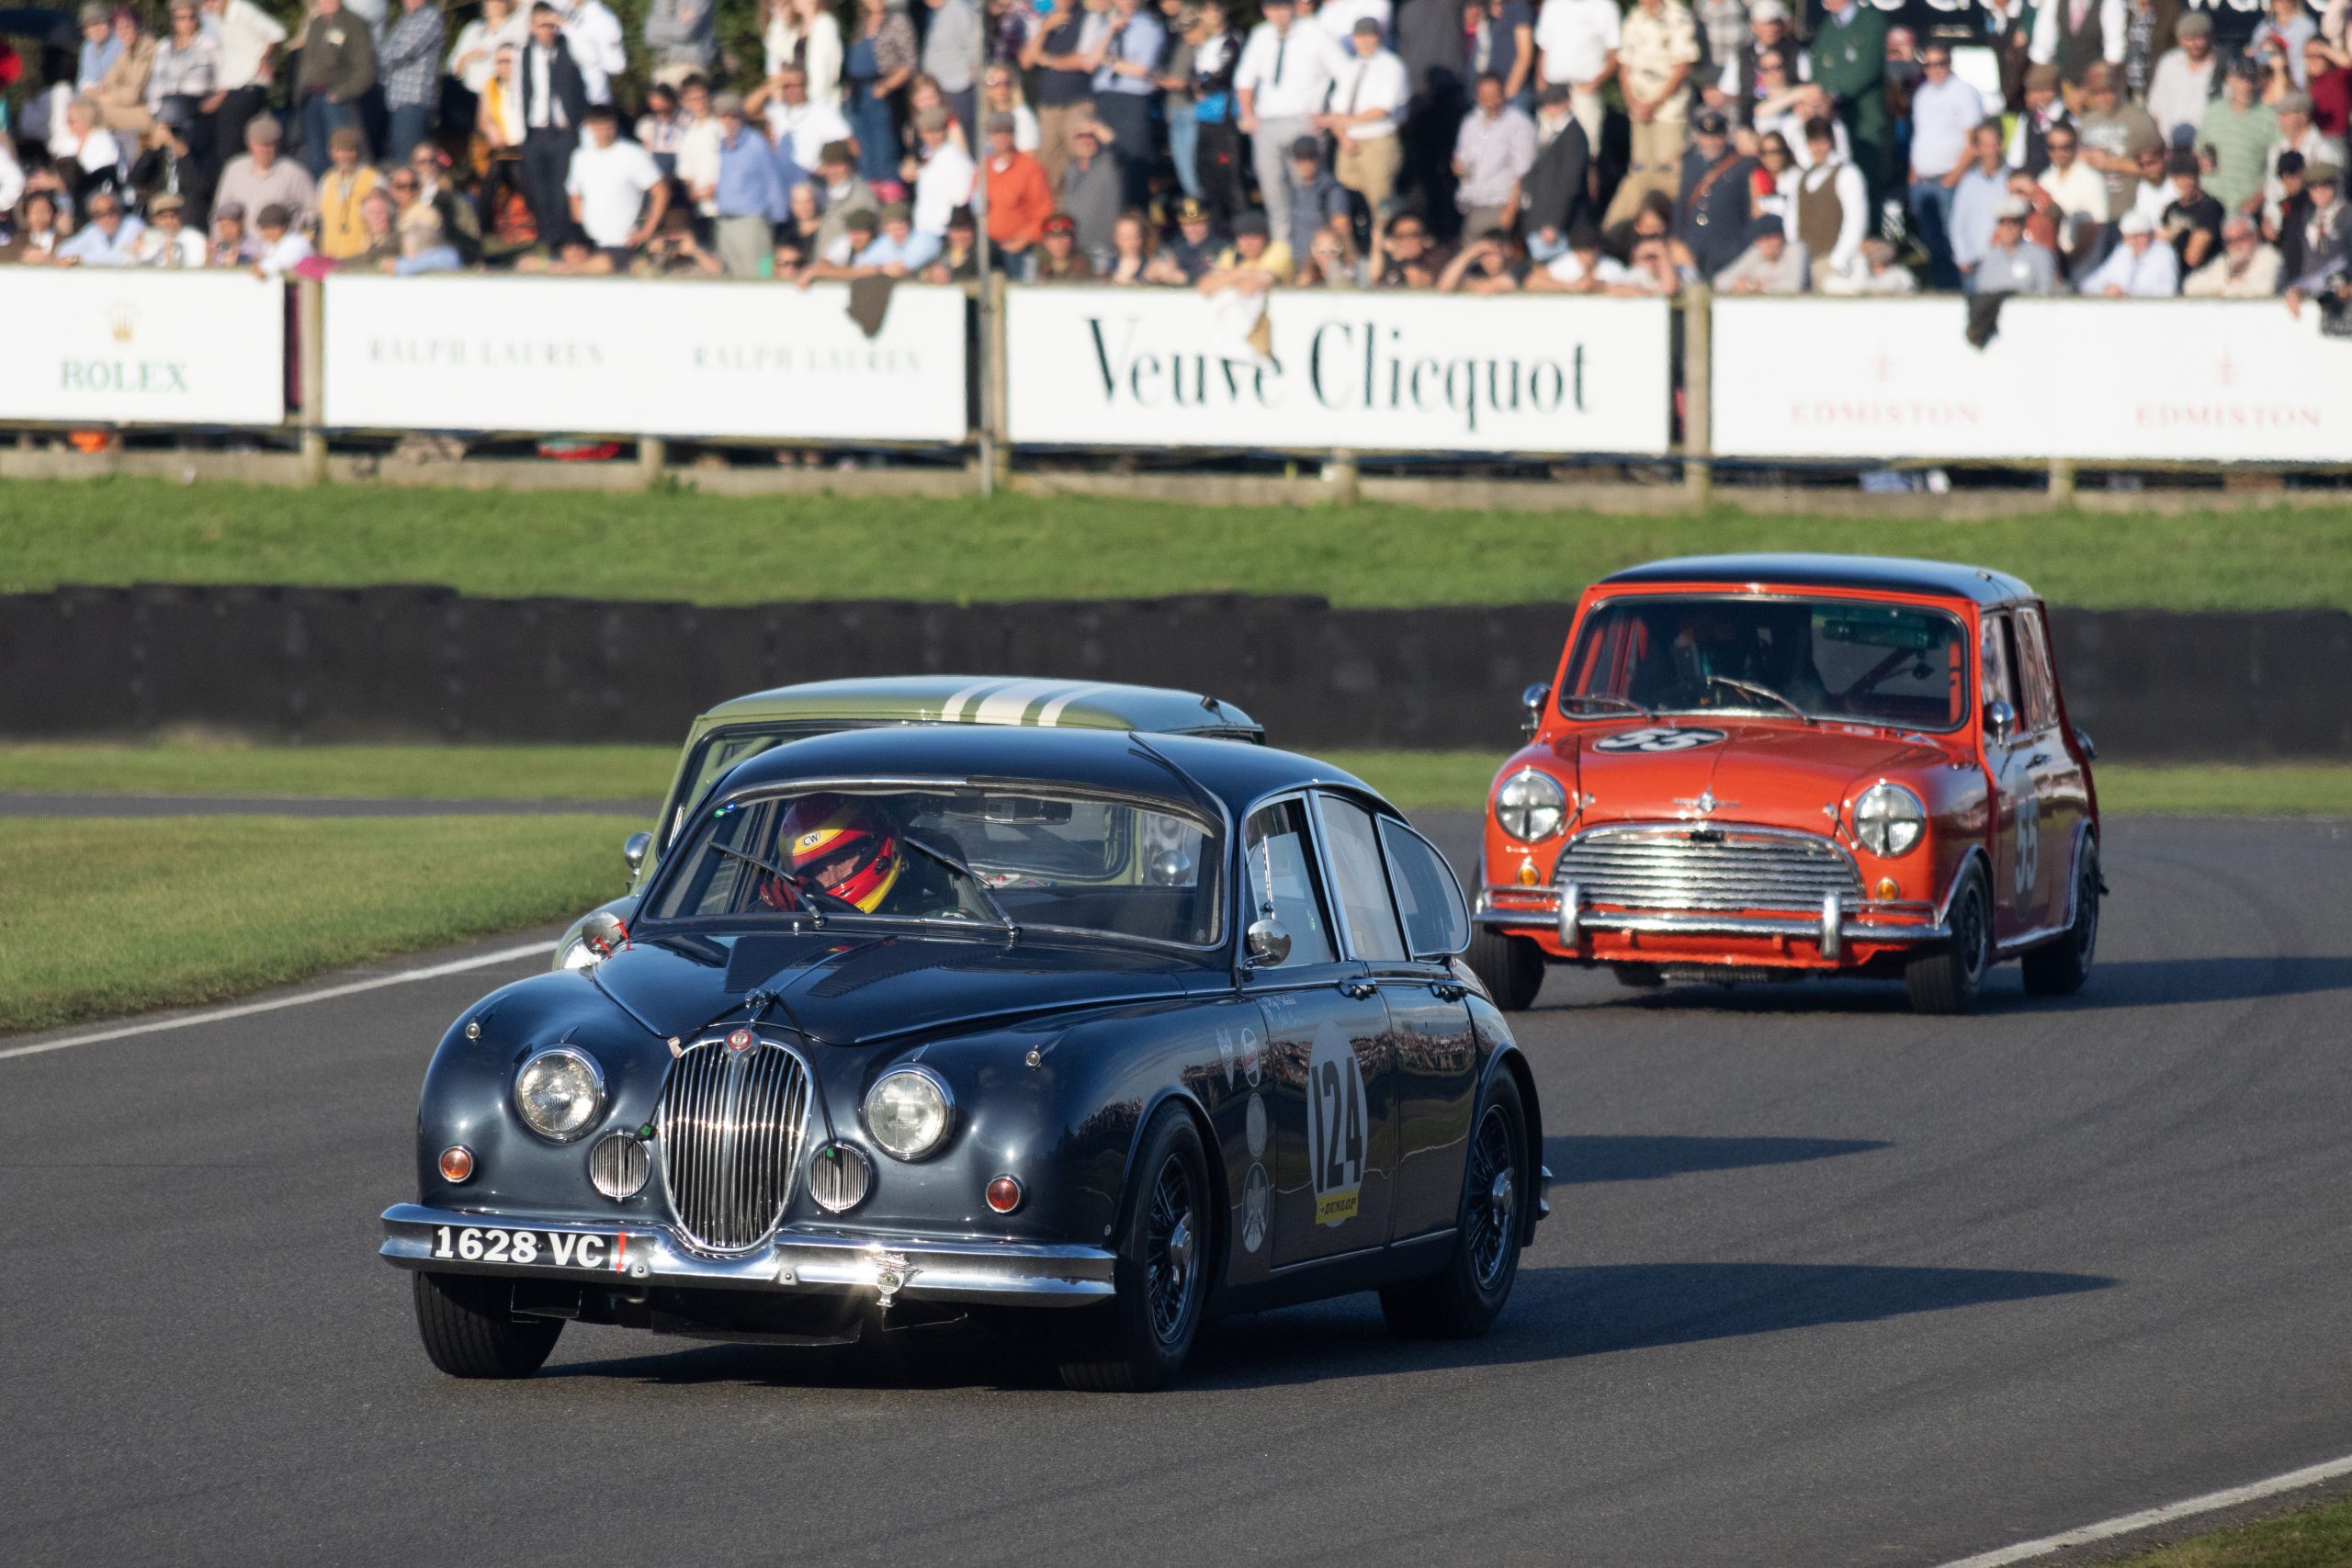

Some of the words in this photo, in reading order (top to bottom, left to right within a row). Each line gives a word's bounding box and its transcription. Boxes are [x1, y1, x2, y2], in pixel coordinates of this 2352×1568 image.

[368, 338, 465, 367] RALPH
[480, 338, 604, 367] LAUREN
[693, 345, 792, 371] RALPH
[808, 345, 922, 372] LAUREN
[61, 359, 188, 392] ROLEX
[1085, 318, 1284, 406] Veuve
[1309, 321, 1595, 432] Clicquot
[1791, 401, 1980, 425] EDMISTON
[2136, 402, 2322, 428] EDMISTON
[1598, 728, 1720, 751] 55
[803, 832, 820, 845] CW
[2015, 795, 2039, 897] 55
[1311, 1057, 1363, 1193] 124
[1324, 1197, 1357, 1215] DUNLOP
[435, 1225, 538, 1264] 1628
[548, 1233, 605, 1269] VC
